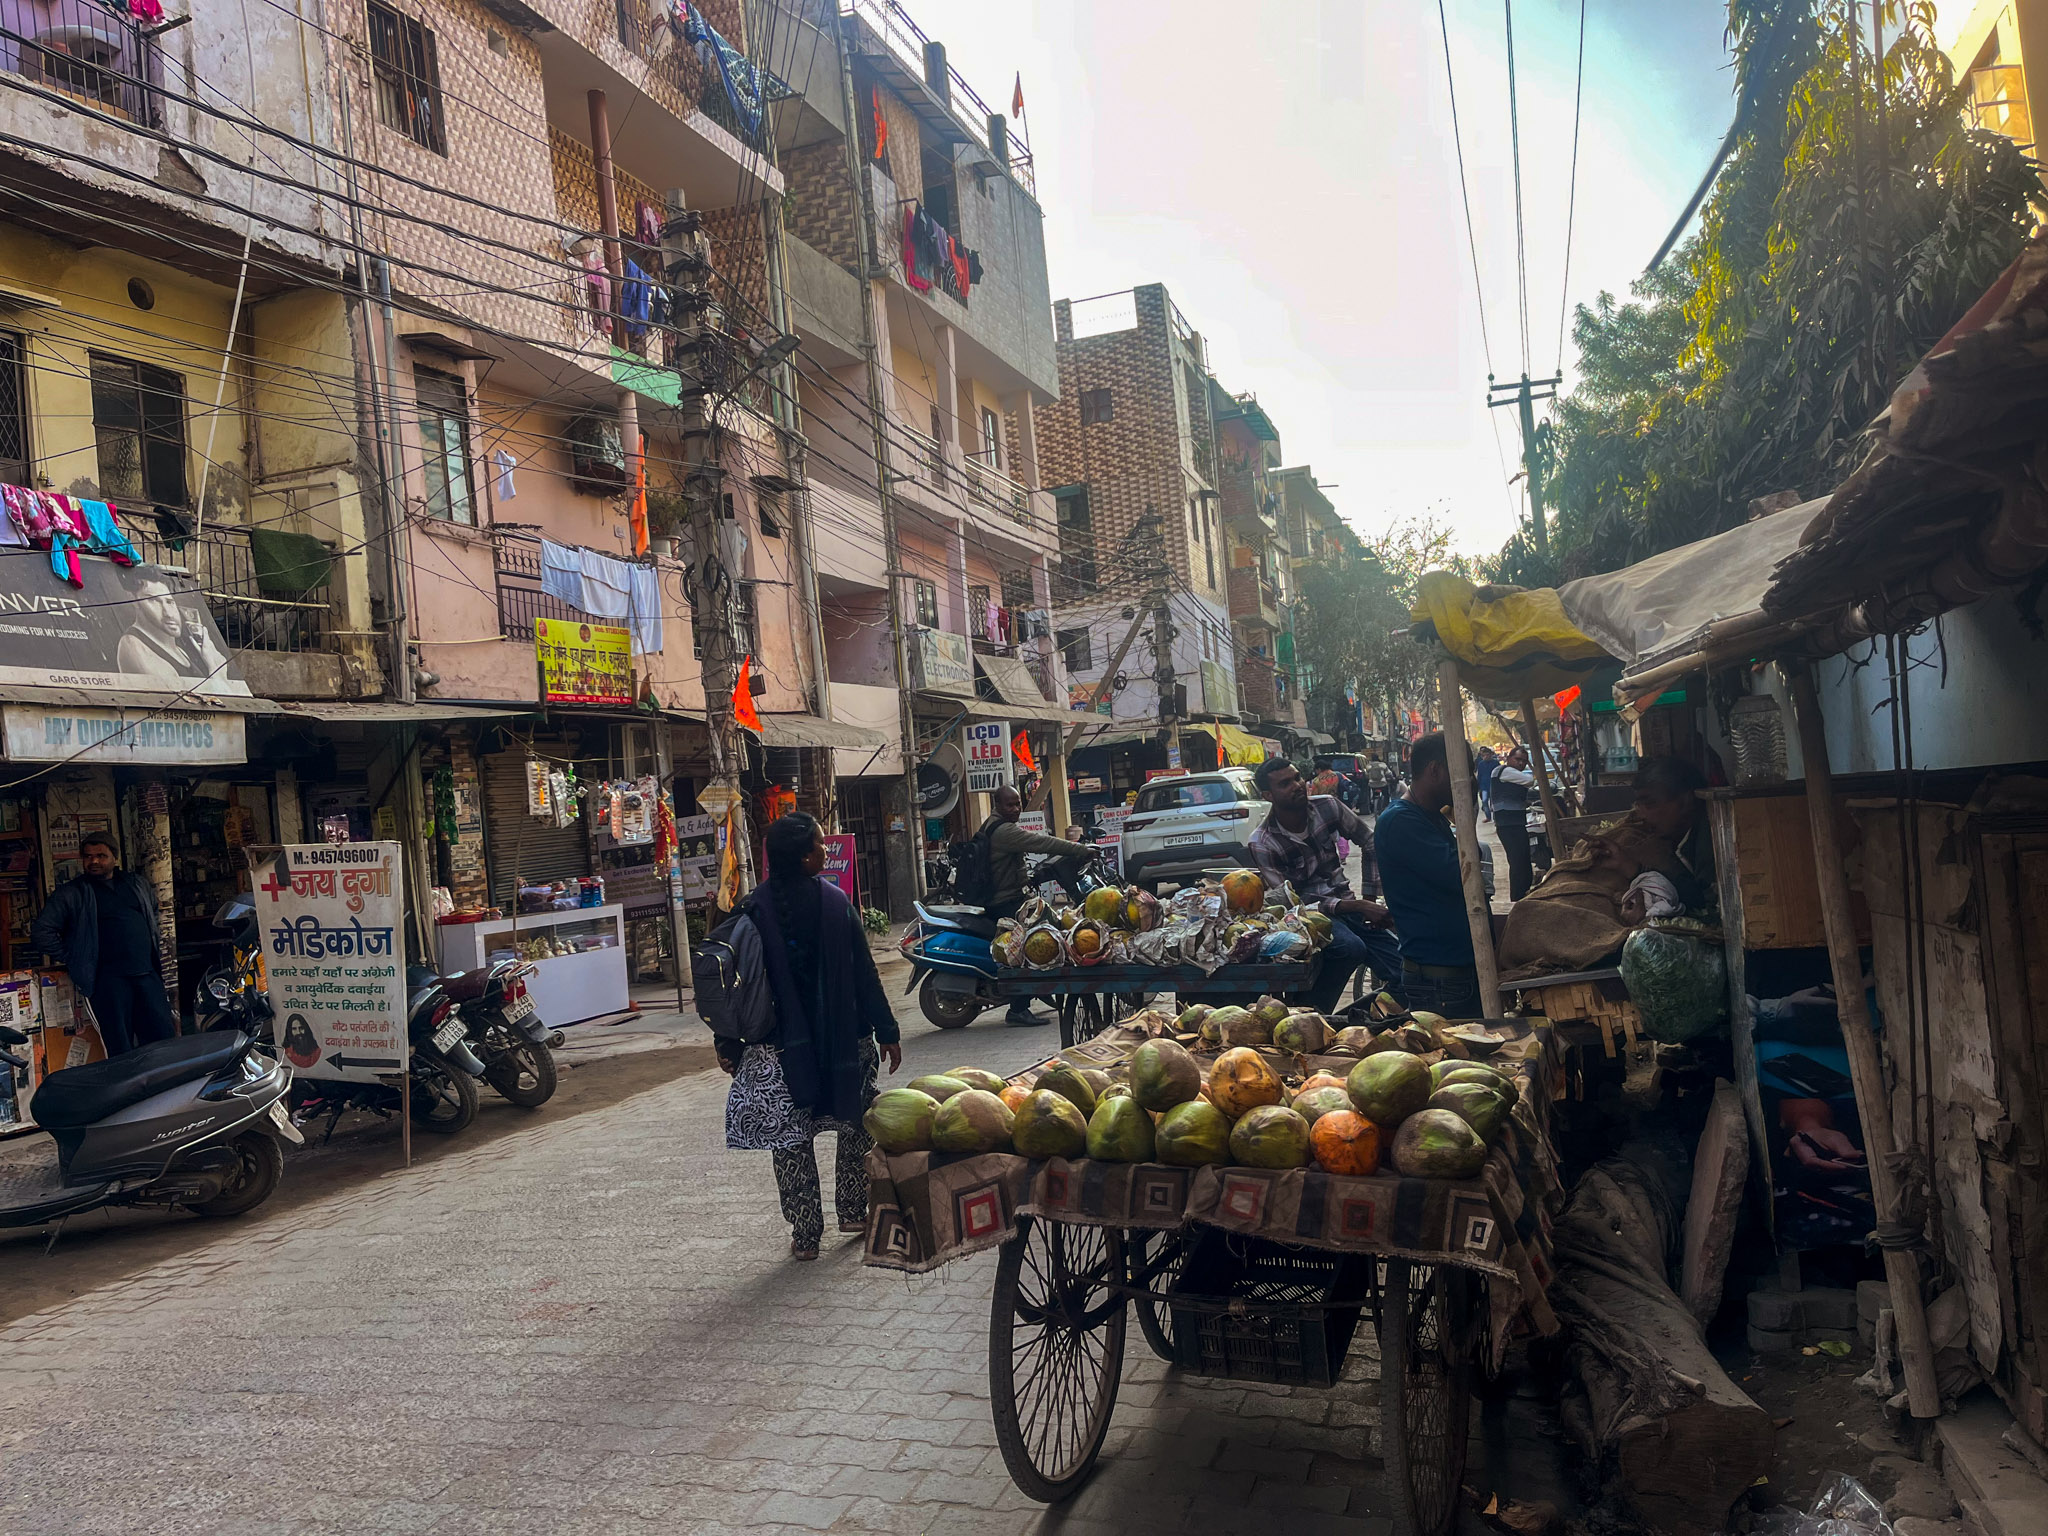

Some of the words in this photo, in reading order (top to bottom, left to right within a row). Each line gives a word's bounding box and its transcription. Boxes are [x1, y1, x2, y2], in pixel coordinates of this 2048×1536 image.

[30, 627, 45, 637] FOR
[45, 629, 56, 638] MY
[56, 629, 88, 640] SUCCESS
[925, 661, 971, 682] ELECTRONICS
[49, 675, 79, 684] GARG
[80, 677, 112, 686] STORE
[44, 717, 73, 745] JAY
[140, 720, 214, 748] MEDICOS
[967, 725, 1000, 740] LCD
[971, 744, 1002, 760] LED
[687, 819, 694, 832] &
[311, 849, 379, 864] 9457496007
[624, 867, 651, 875] Exclusive
[290, 870, 335, 898] जय
[341, 856, 392, 913] दुर्गा
[270, 915, 394, 961] मेडिकोज
[272, 966, 297, 977] हमारे
[300, 966, 319, 978] यहाँ
[322, 966, 341, 978] यहाँ
[344, 968, 358, 977] पर
[361, 966, 395, 979] अंग्रेजी
[285, 985, 292, 993] व
[347, 983, 385, 995] दवाईया
[311, 1000, 324, 1009] रेट
[326, 1001, 339, 1010] पर
[341, 1000, 375, 1011] मिलती
[508, 995, 529, 1013] UP4D
[350, 1021, 377, 1032] पतंजलि
[380, 1022, 389, 1032] की
[352, 1038, 360, 1047] भी
[152, 1116, 215, 1142] Jupiter
